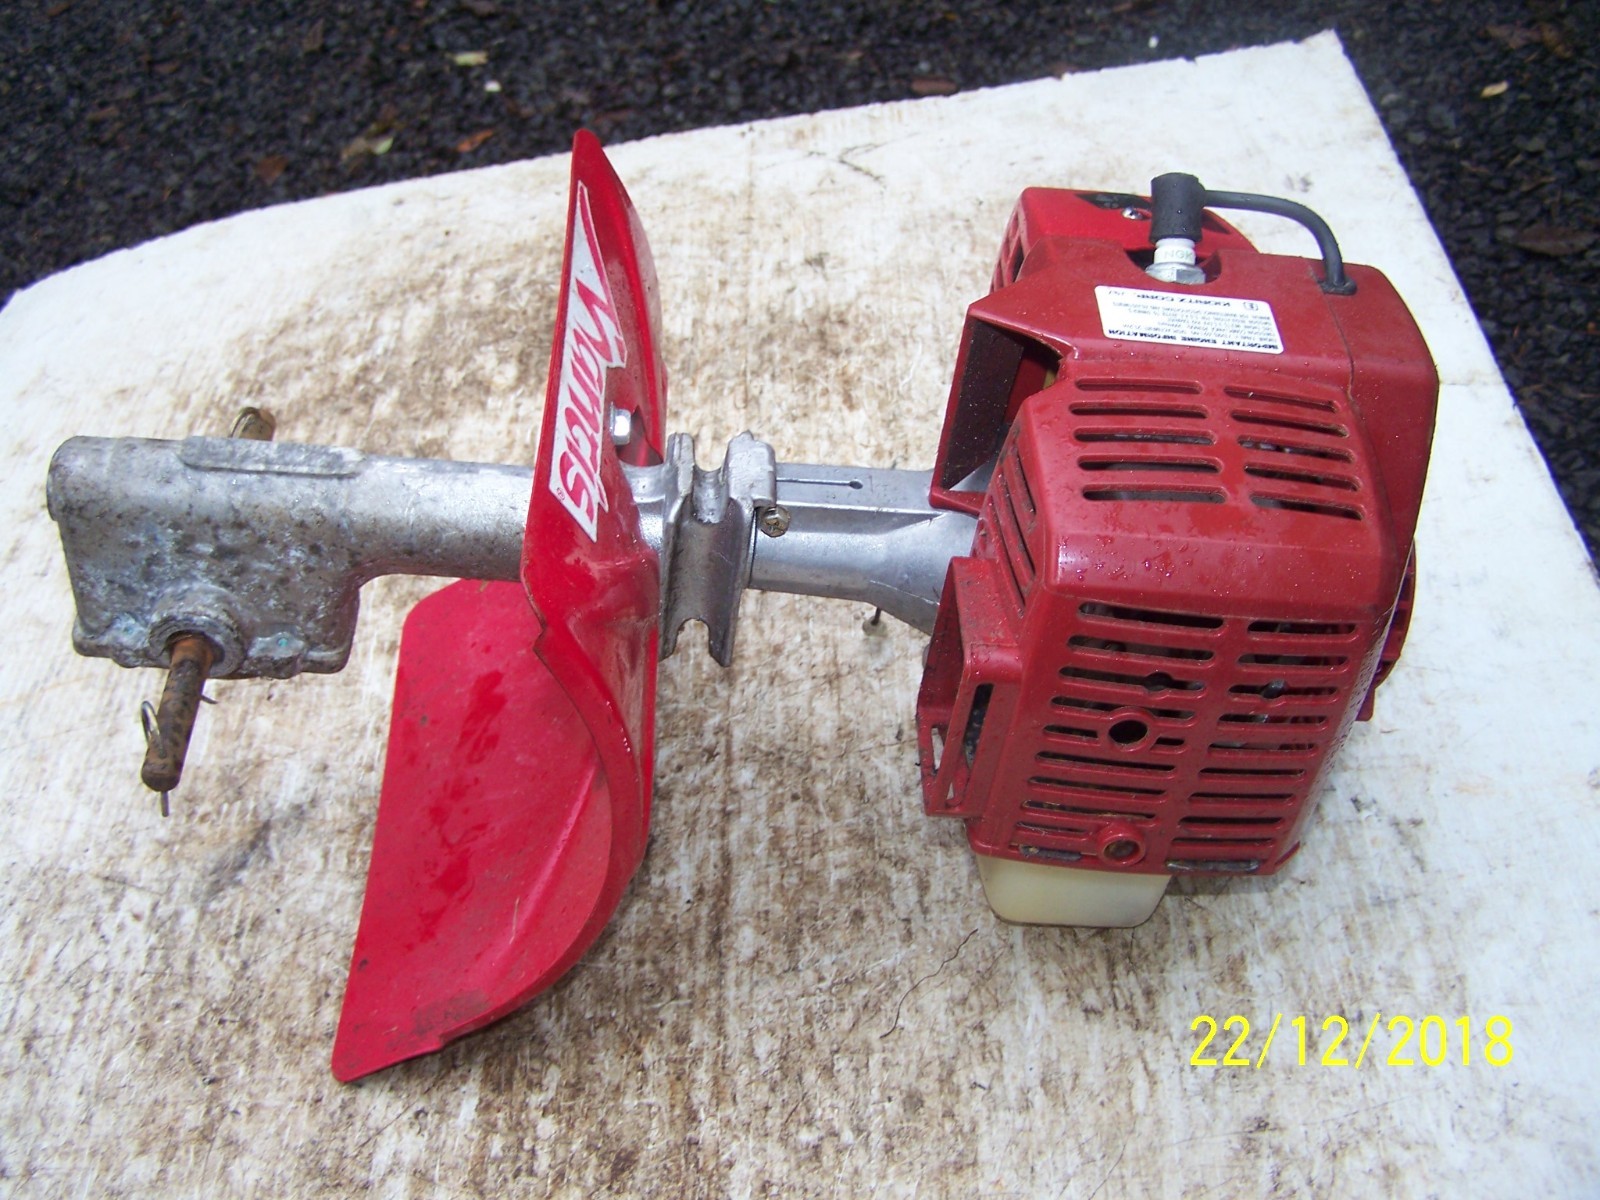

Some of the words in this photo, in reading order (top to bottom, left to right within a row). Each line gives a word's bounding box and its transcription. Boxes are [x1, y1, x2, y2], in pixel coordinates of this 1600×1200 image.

[1164, 249, 1194, 260] NGK
[1108, 329, 1177, 341] INFORMATION
[1181, 335, 1217, 344] ENGINE
[1222, 340, 1279, 350] IMPORTANT
